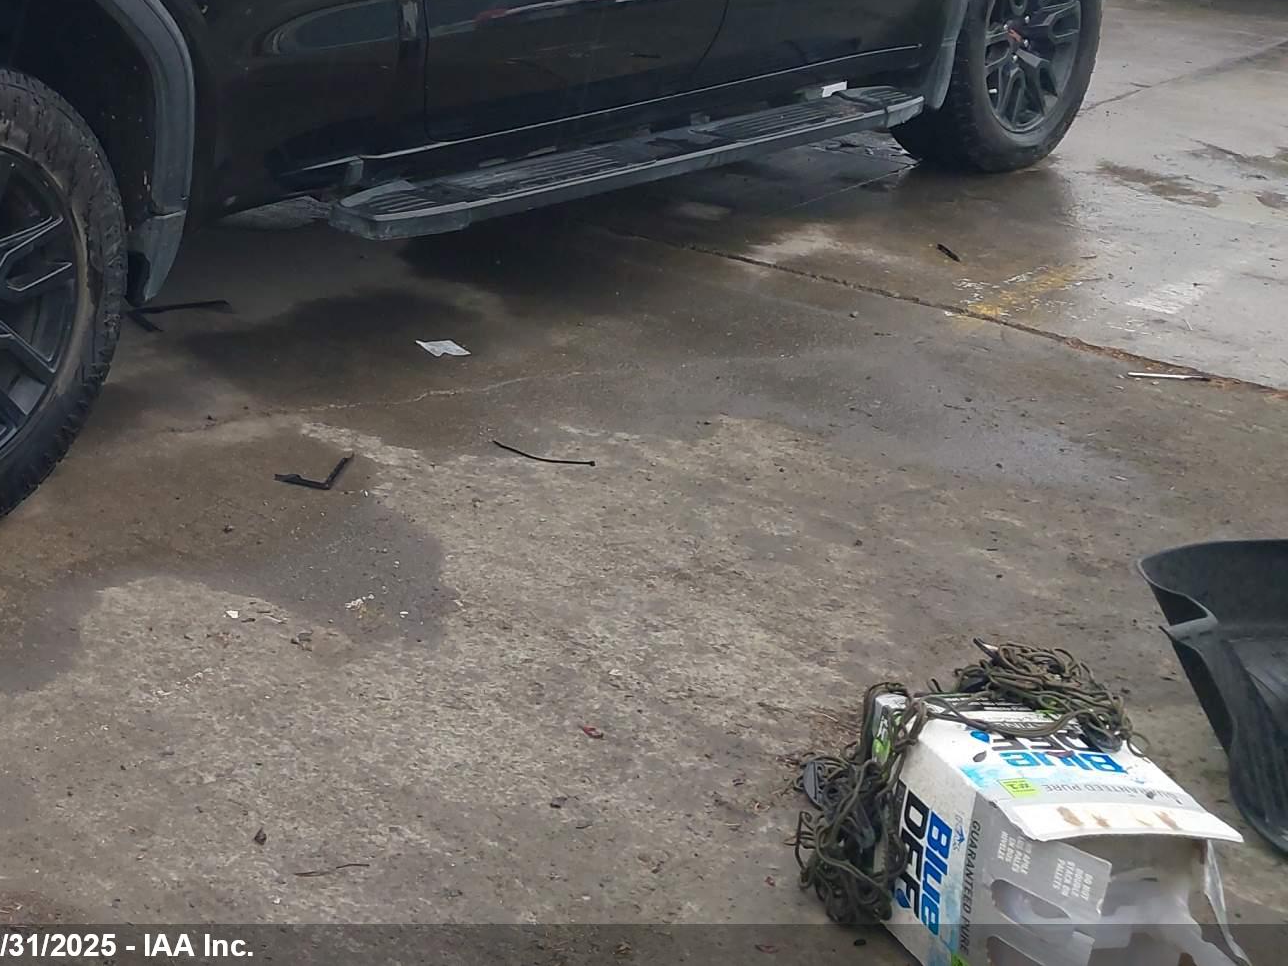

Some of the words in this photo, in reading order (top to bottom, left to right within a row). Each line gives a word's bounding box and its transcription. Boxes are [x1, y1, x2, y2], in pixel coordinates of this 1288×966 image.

[999, 752, 1128, 774] Blue
[920, 810, 953, 936] Blue
[961, 820, 981, 914] GUARANTEED
[959, 916, 972, 956] PURE
